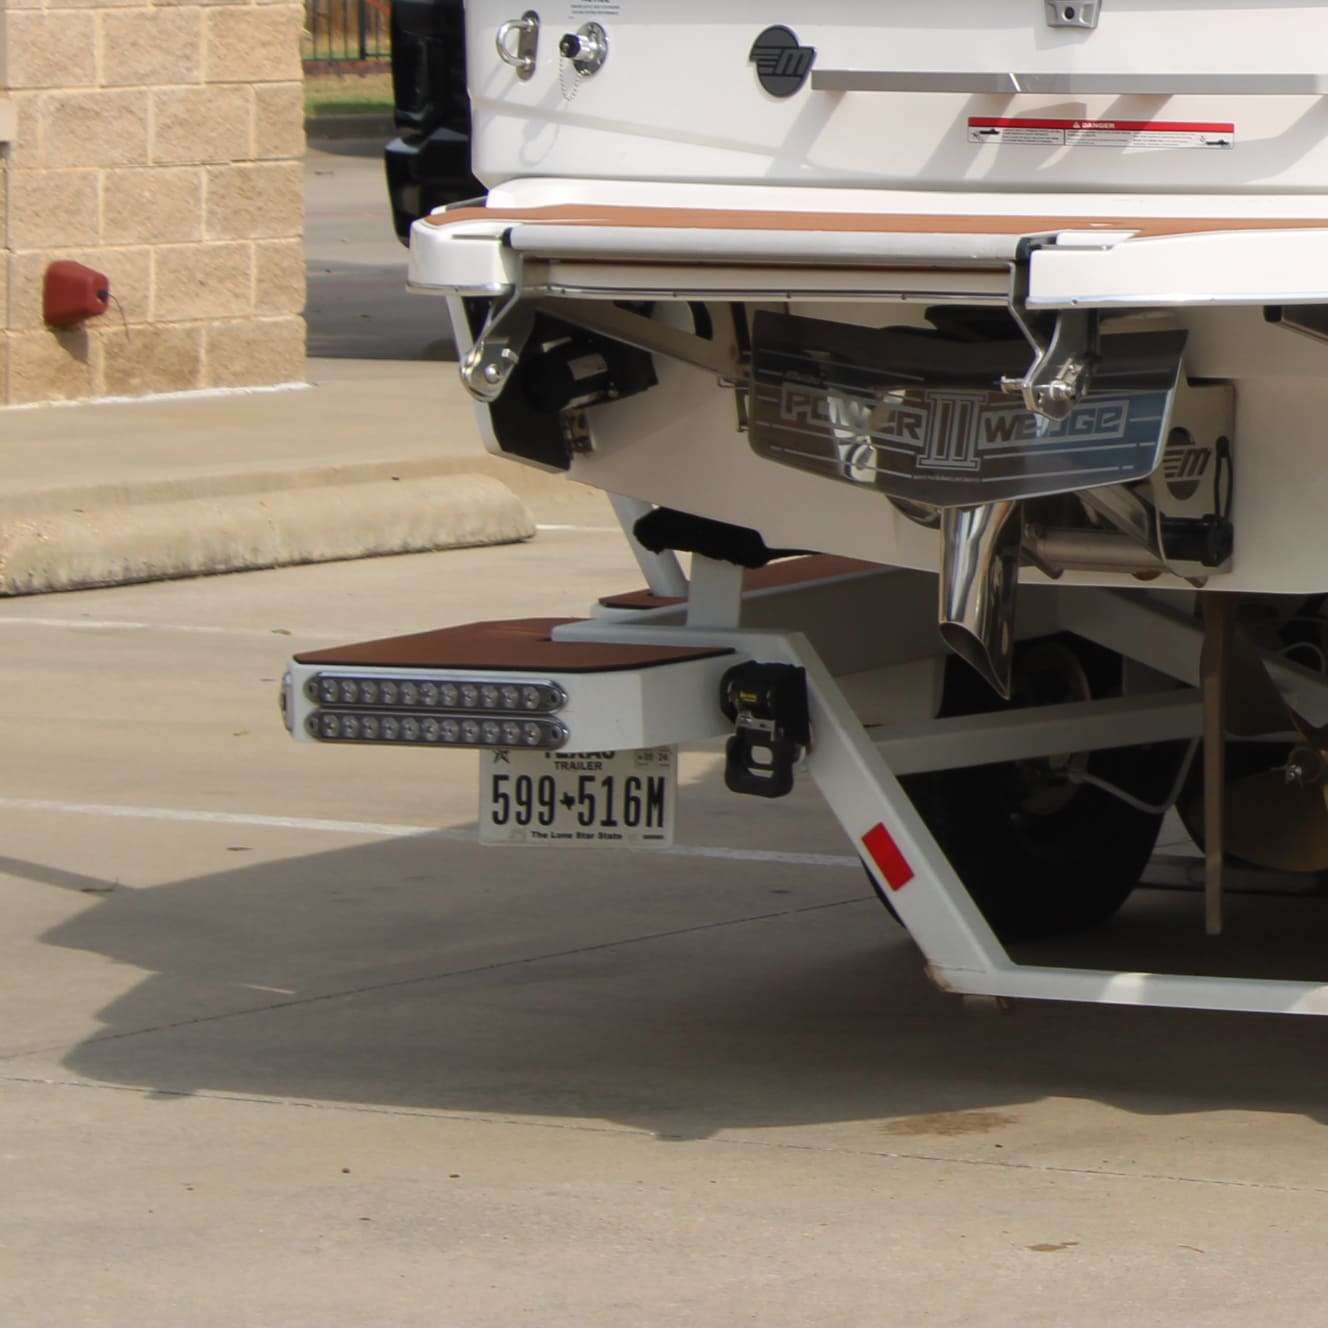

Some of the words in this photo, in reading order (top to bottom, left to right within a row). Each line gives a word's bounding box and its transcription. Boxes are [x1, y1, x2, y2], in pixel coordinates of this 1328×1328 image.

[553, 761, 603, 770] TRAILER
[531, 831, 547, 839] The
[551, 831, 573, 839] Lone
[576, 832, 595, 840] Star
[598, 832, 623, 840] State
